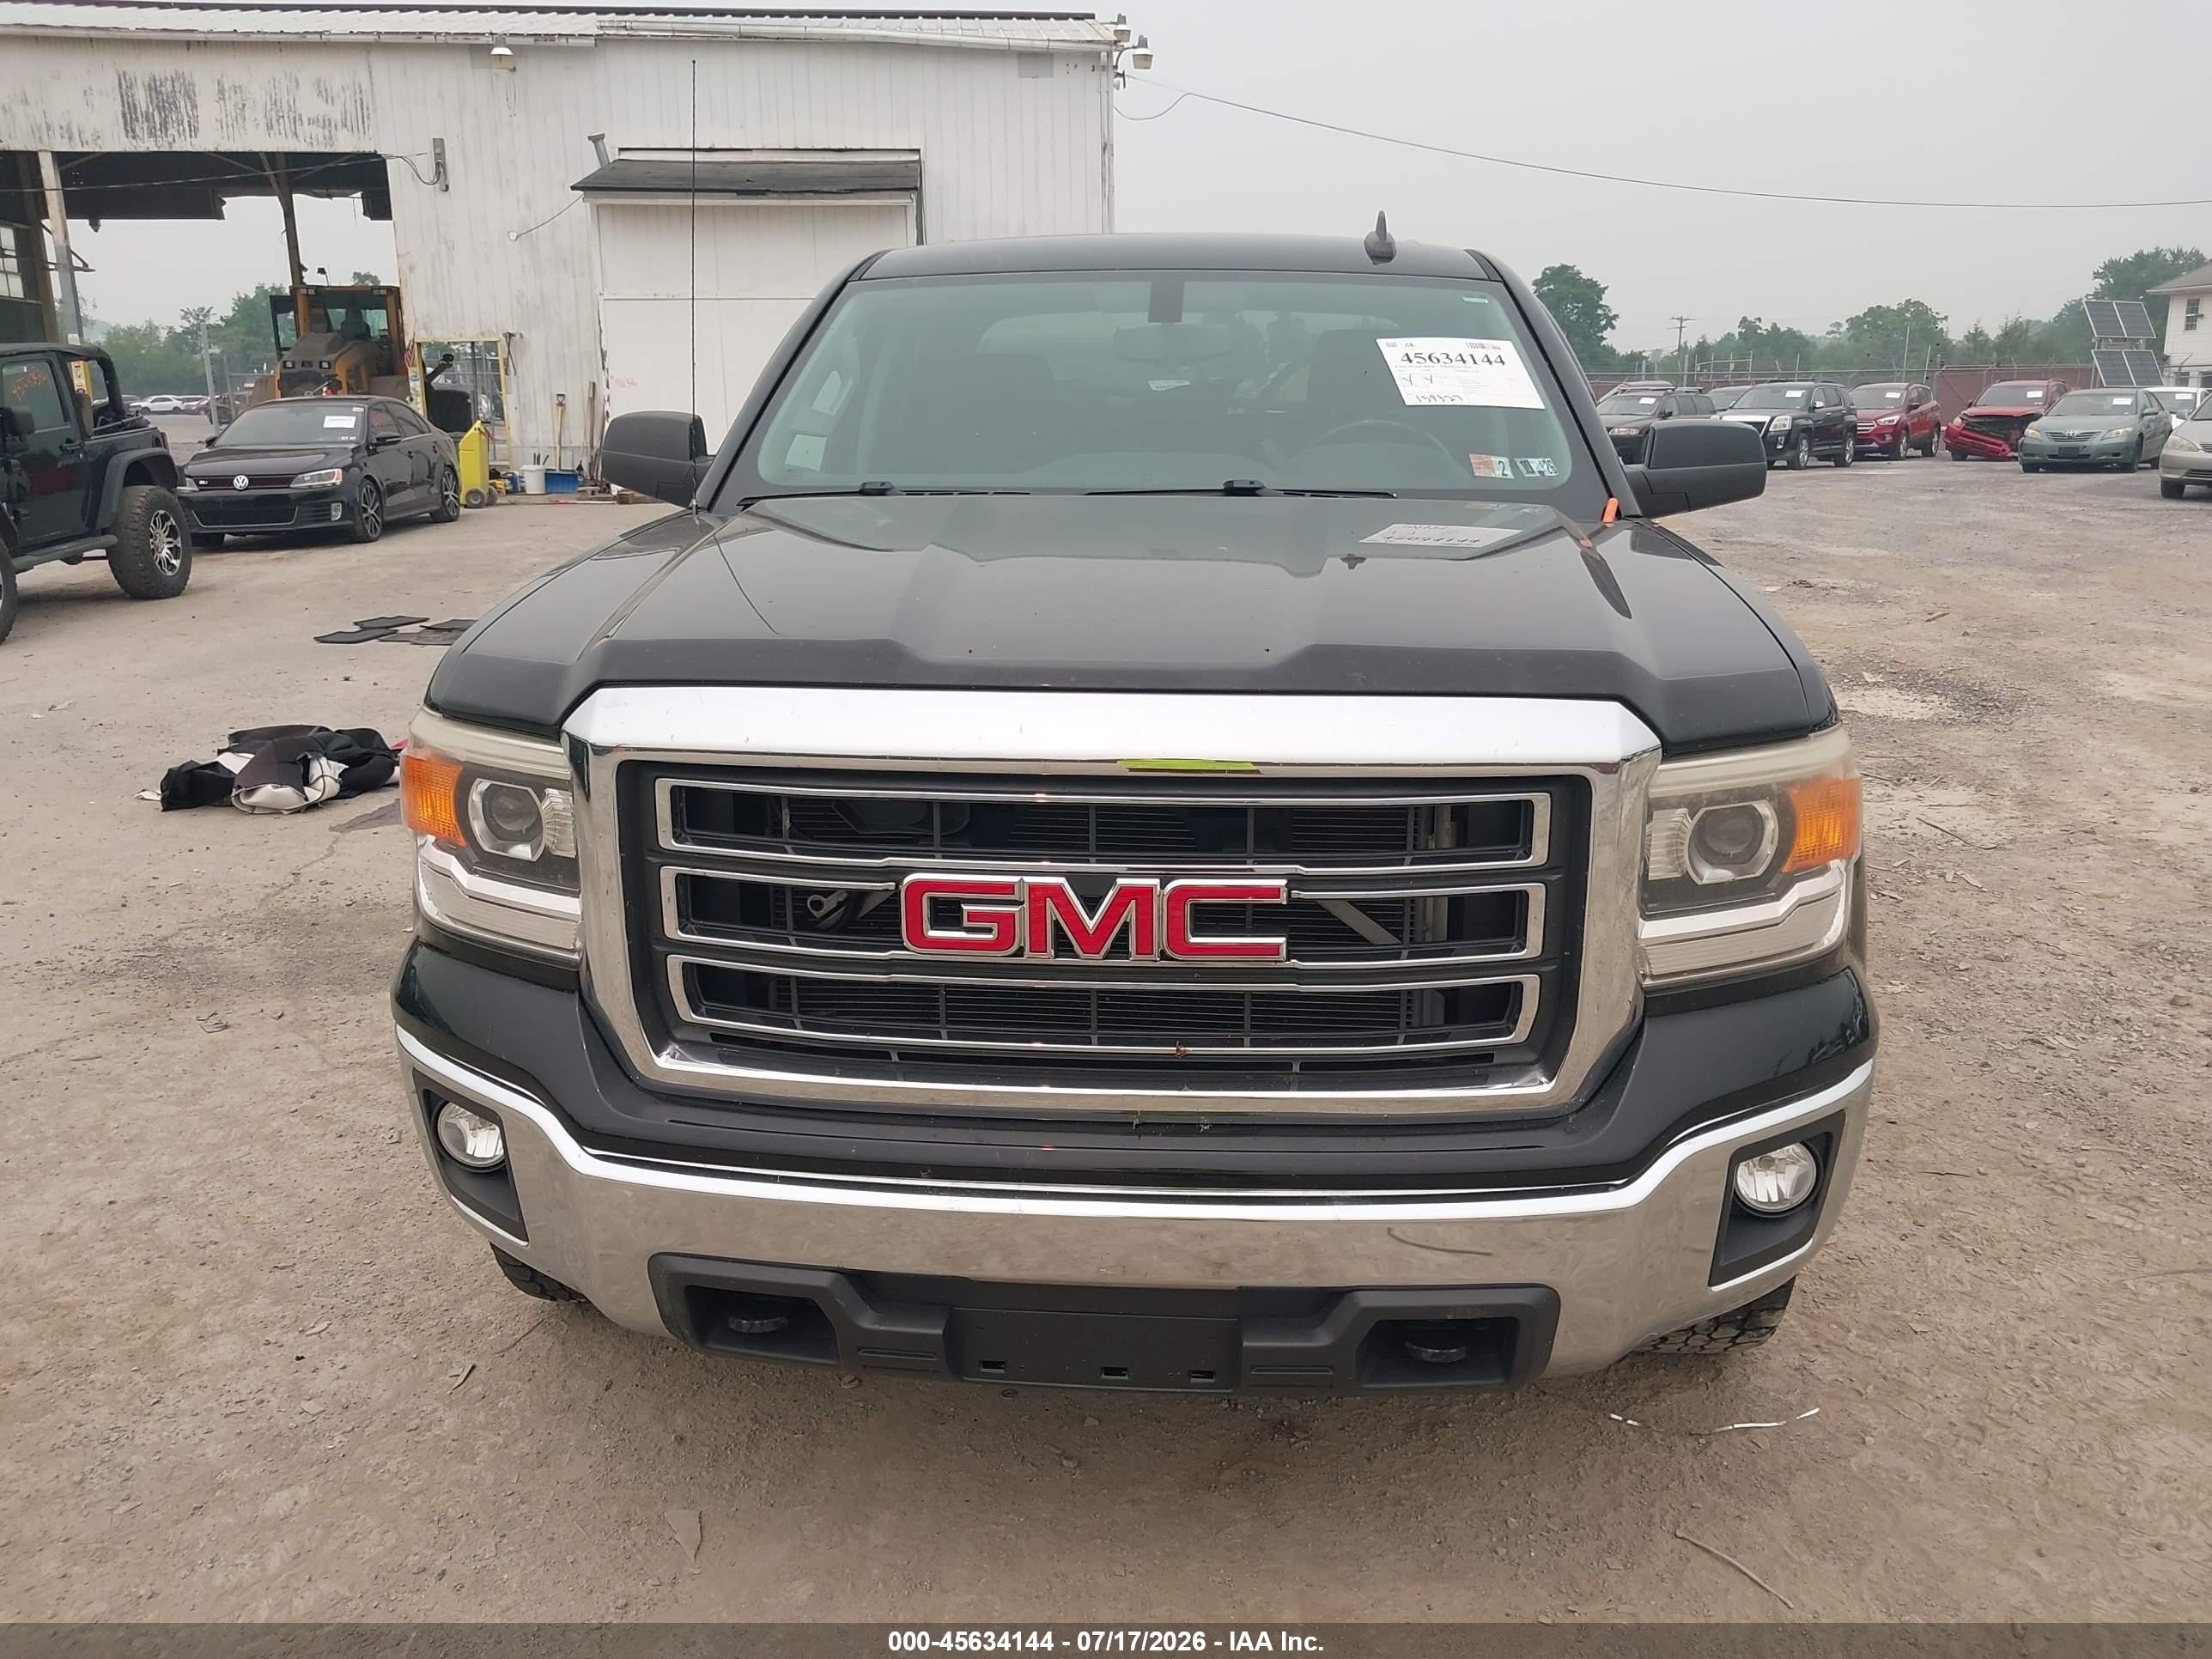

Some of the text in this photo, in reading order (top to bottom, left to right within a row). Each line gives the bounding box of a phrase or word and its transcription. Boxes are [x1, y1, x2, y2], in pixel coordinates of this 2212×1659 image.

[1401, 352, 1505, 367] 45634144
[1498, 460, 1508, 477] 2
[234, 475, 249, 490] VW
[902, 872, 1288, 961] GMC
